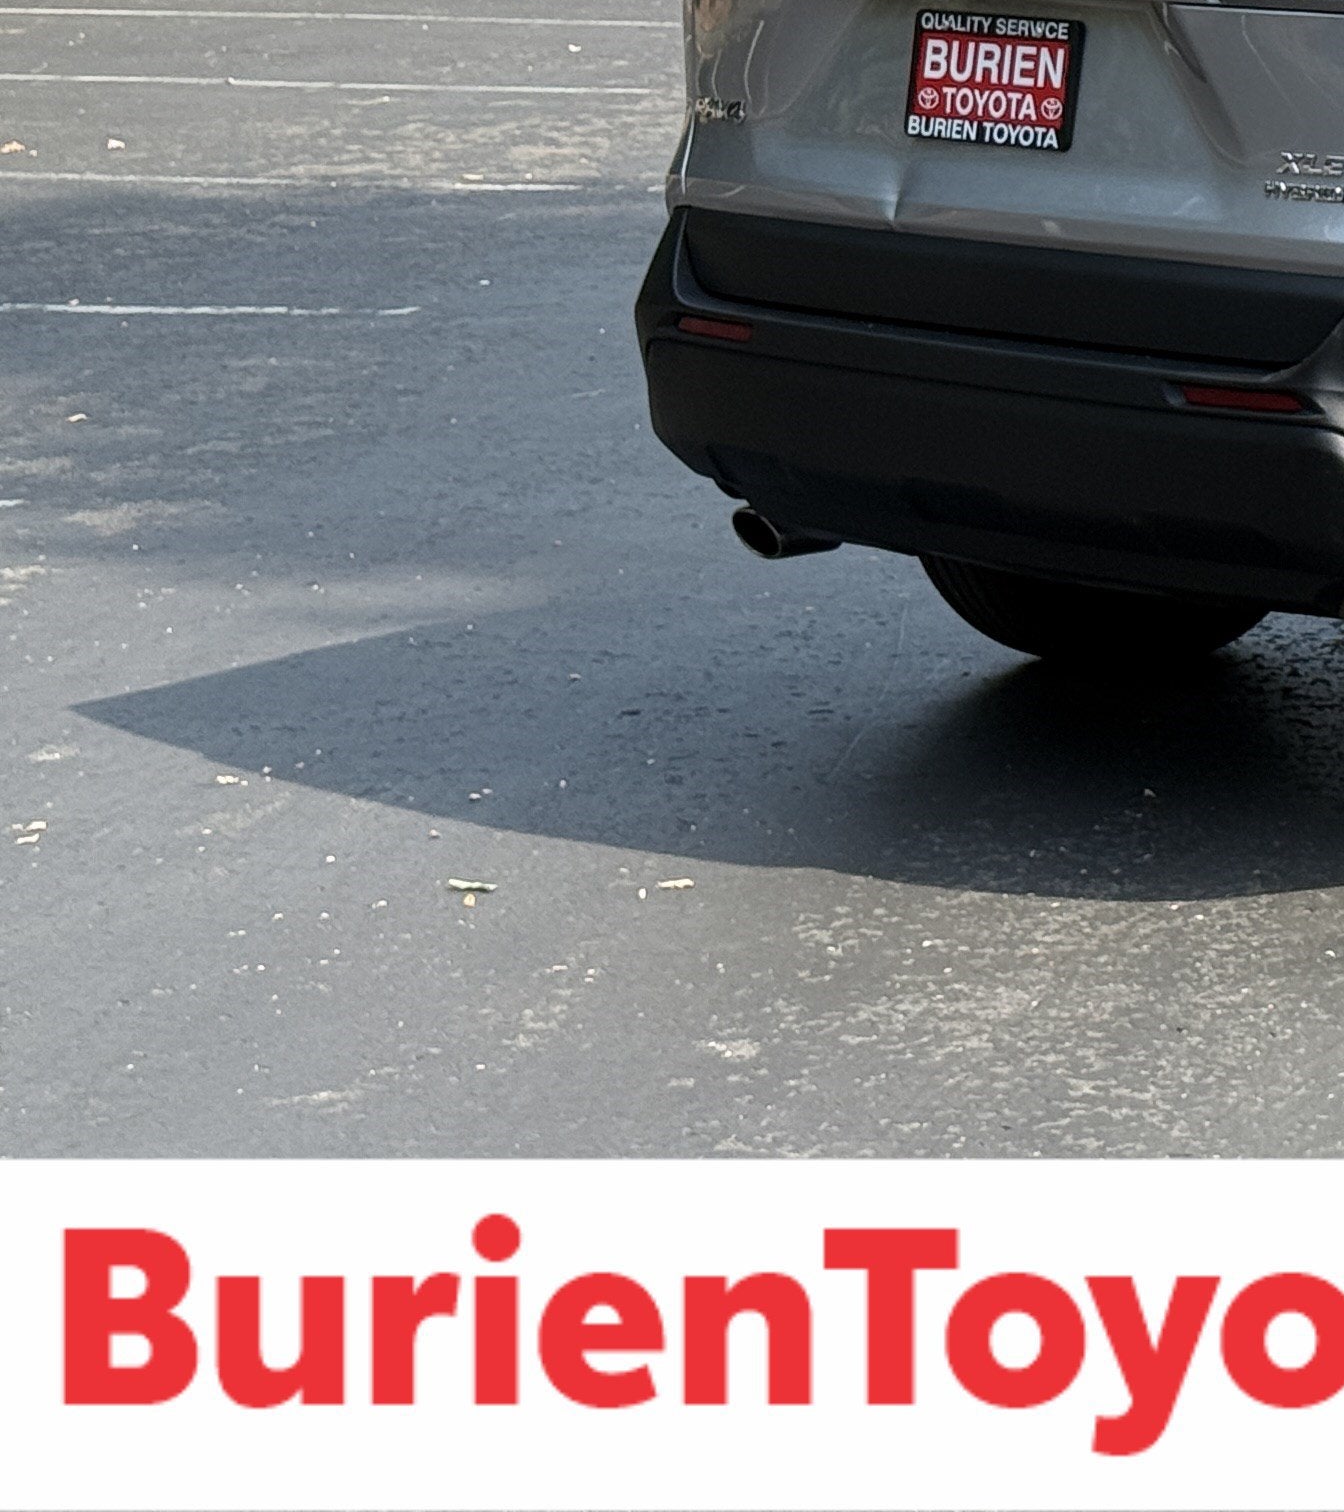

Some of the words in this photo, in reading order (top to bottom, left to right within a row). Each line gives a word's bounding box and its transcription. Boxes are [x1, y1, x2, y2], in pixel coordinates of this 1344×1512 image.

[921, 11, 993, 34] QUALITY
[996, 17, 1069, 40] SERVICE
[923, 38, 1066, 89] BURIEN
[942, 86, 1037, 121] TOYOTA
[907, 114, 978, 141] BURIEN
[982, 120, 1059, 149] TOYOTA
